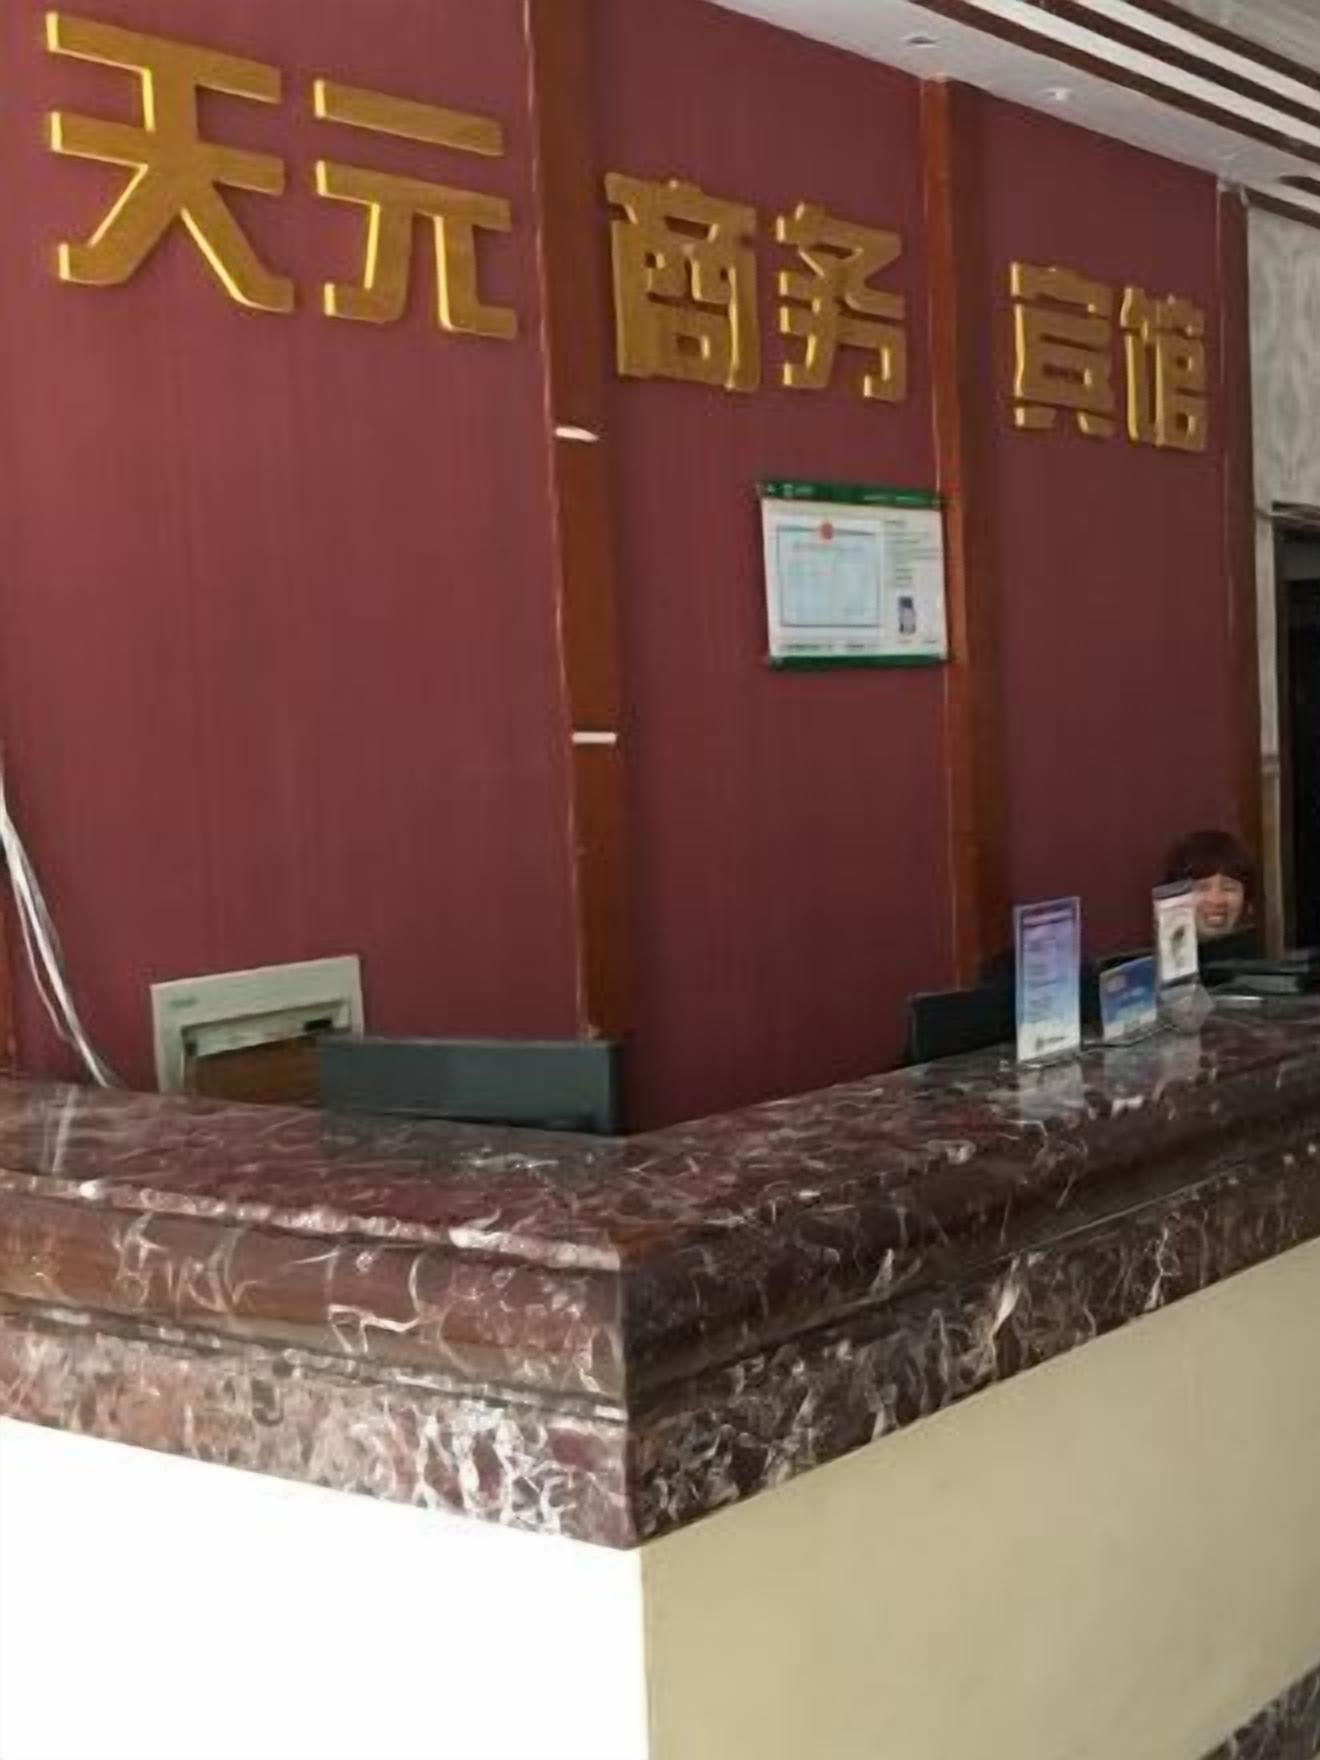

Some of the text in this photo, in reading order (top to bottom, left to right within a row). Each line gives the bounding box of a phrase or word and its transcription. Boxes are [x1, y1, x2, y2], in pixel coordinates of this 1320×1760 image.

[46, 10, 1208, 453] 天元 商务 宾馆
